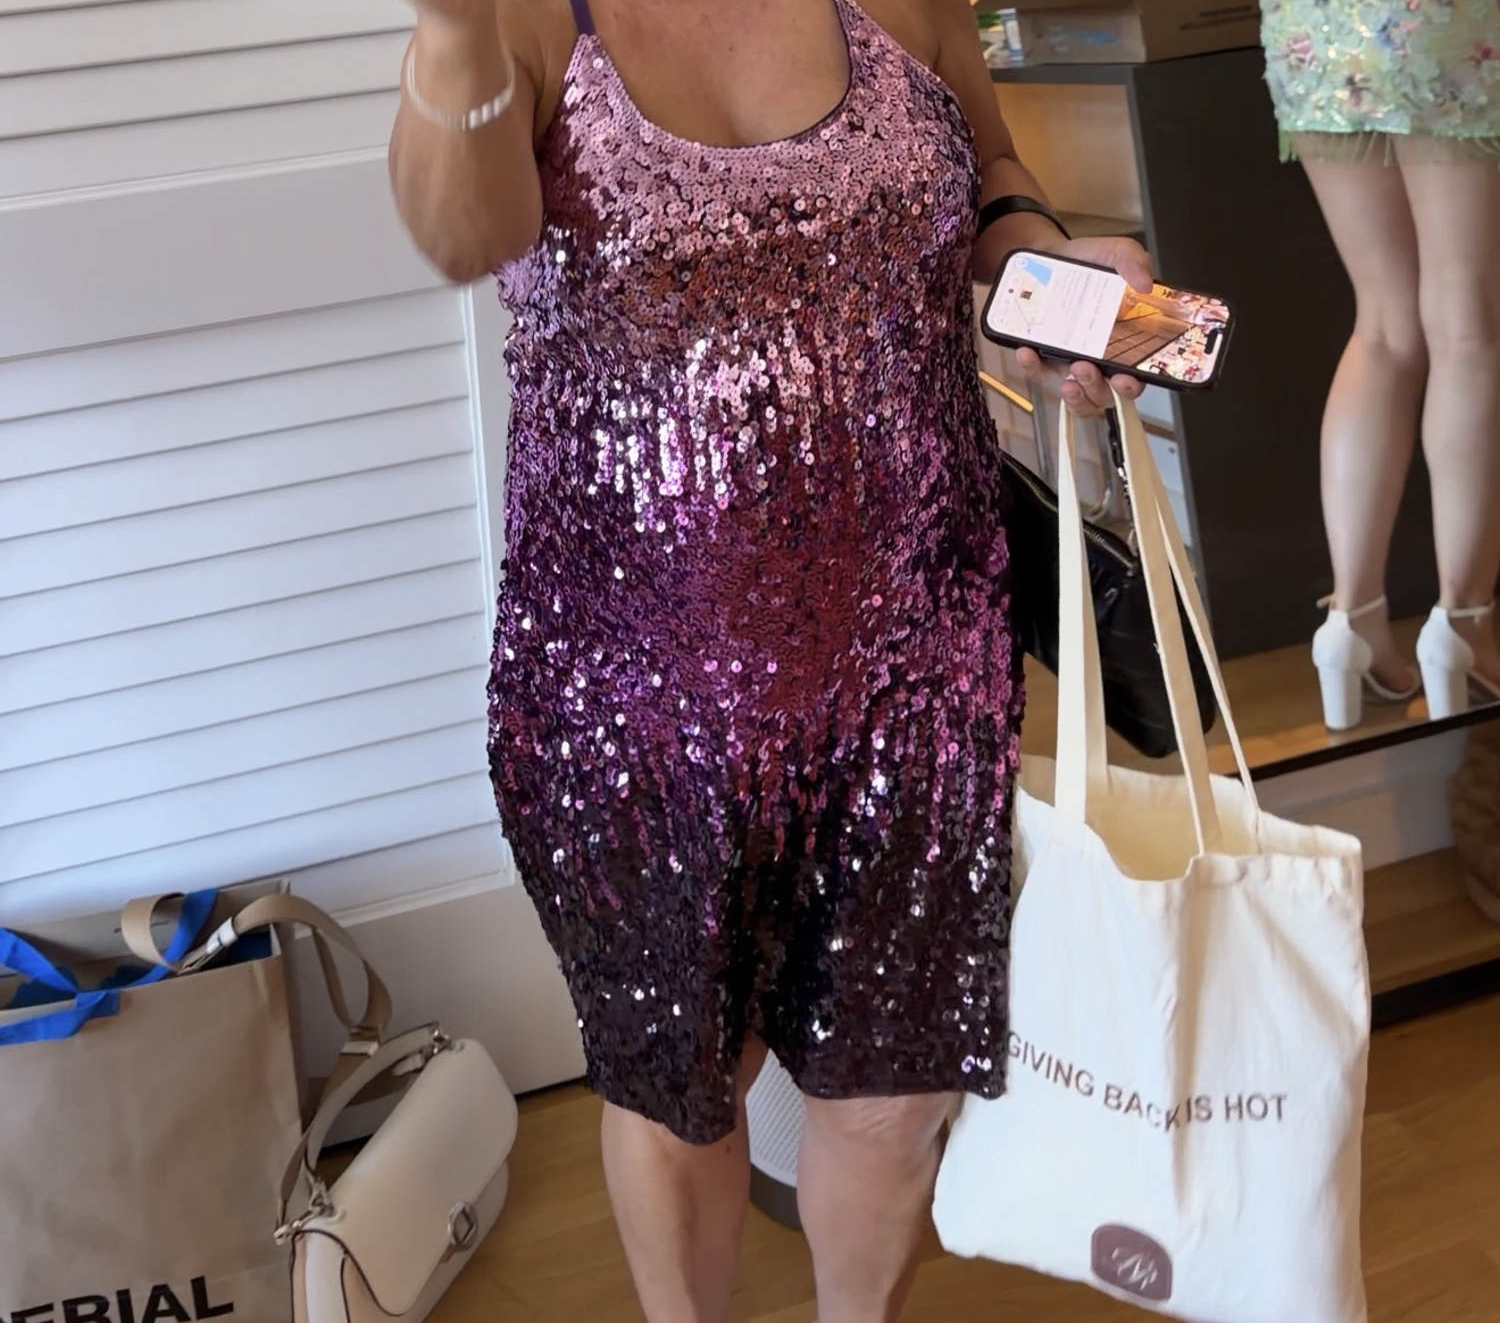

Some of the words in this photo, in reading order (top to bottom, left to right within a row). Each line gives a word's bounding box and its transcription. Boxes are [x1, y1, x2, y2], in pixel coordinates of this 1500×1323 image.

[1006, 1029, 1095, 1098] GIVING
[1103, 1083, 1180, 1133] BACK
[1186, 1094, 1213, 1123] IS
[1225, 1093, 1288, 1122] HOT
[0, 1276, 234, 1323] RIAL
